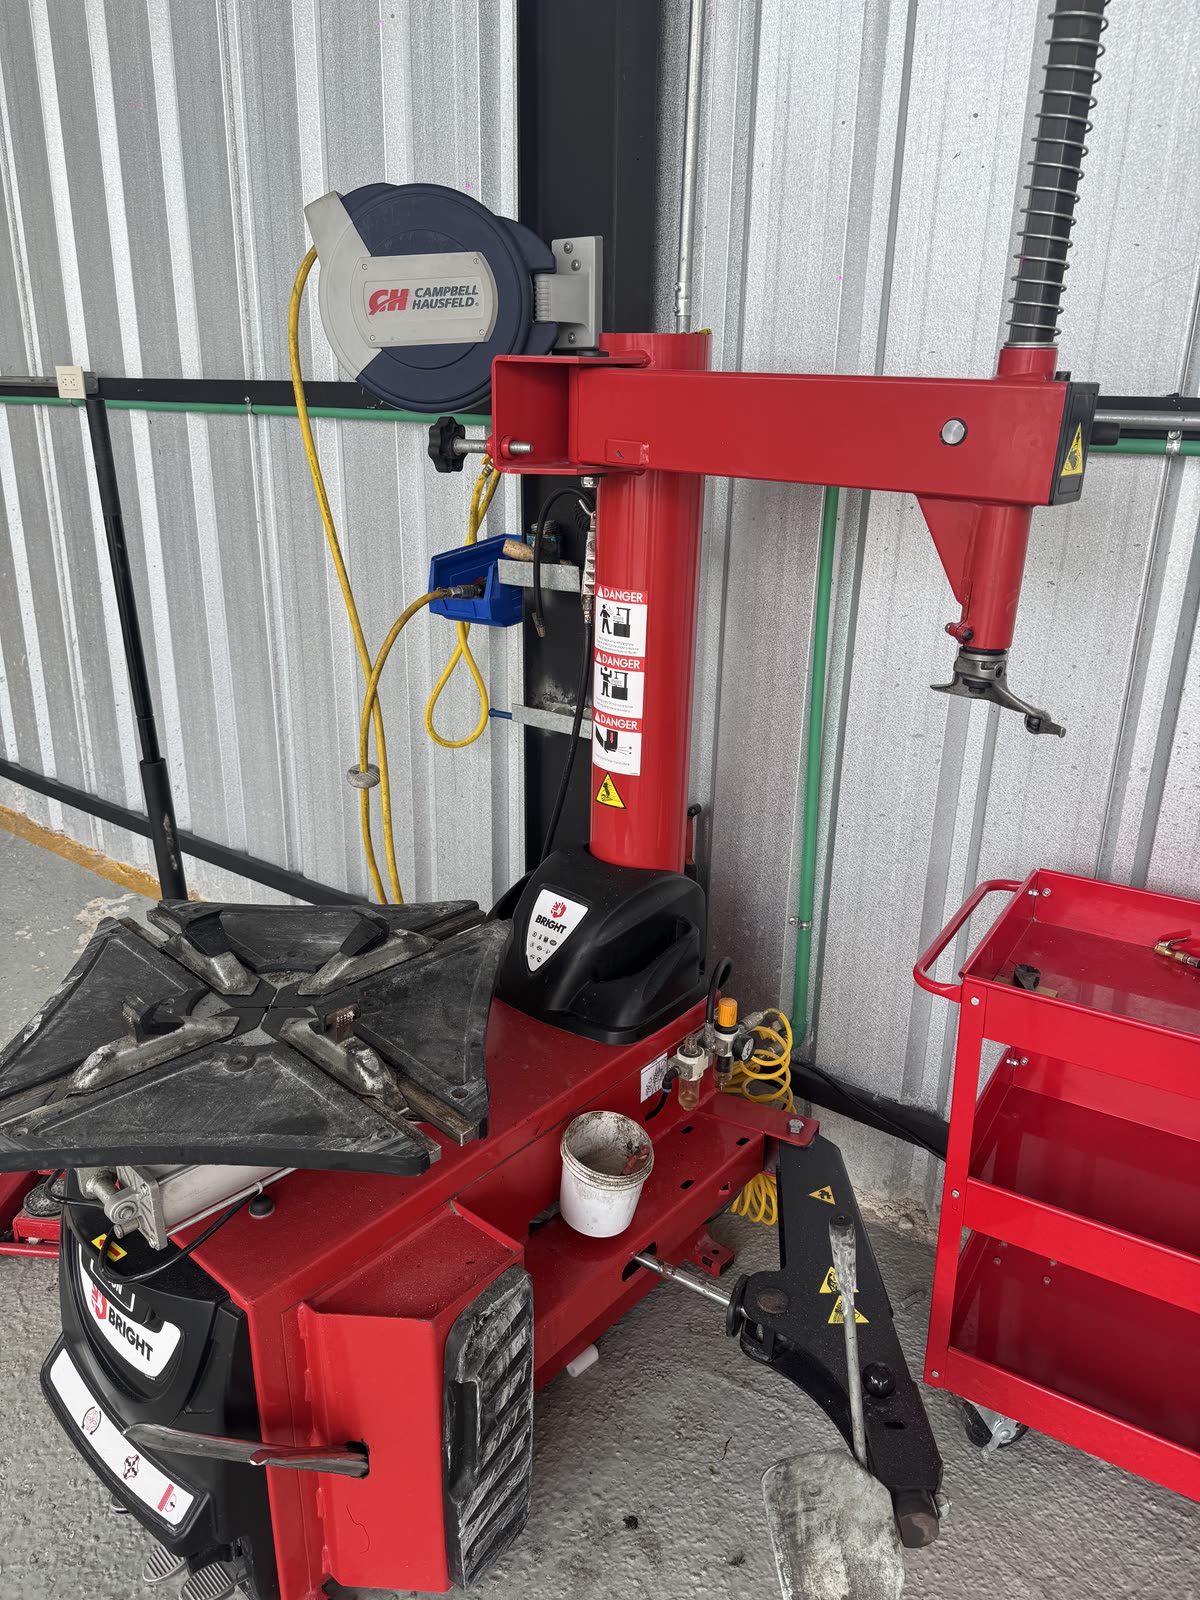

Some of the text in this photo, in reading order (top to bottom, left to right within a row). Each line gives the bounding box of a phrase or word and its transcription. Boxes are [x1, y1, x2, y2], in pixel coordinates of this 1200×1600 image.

[414, 284, 479, 298] CAMPBELL
[603, 587, 644, 603] DANGER
[602, 653, 641, 670] DANGER
[600, 714, 638, 731] DANGER
[534, 914, 568, 935] BRIGHT
[108, 1306, 154, 1362] BRIGHT
